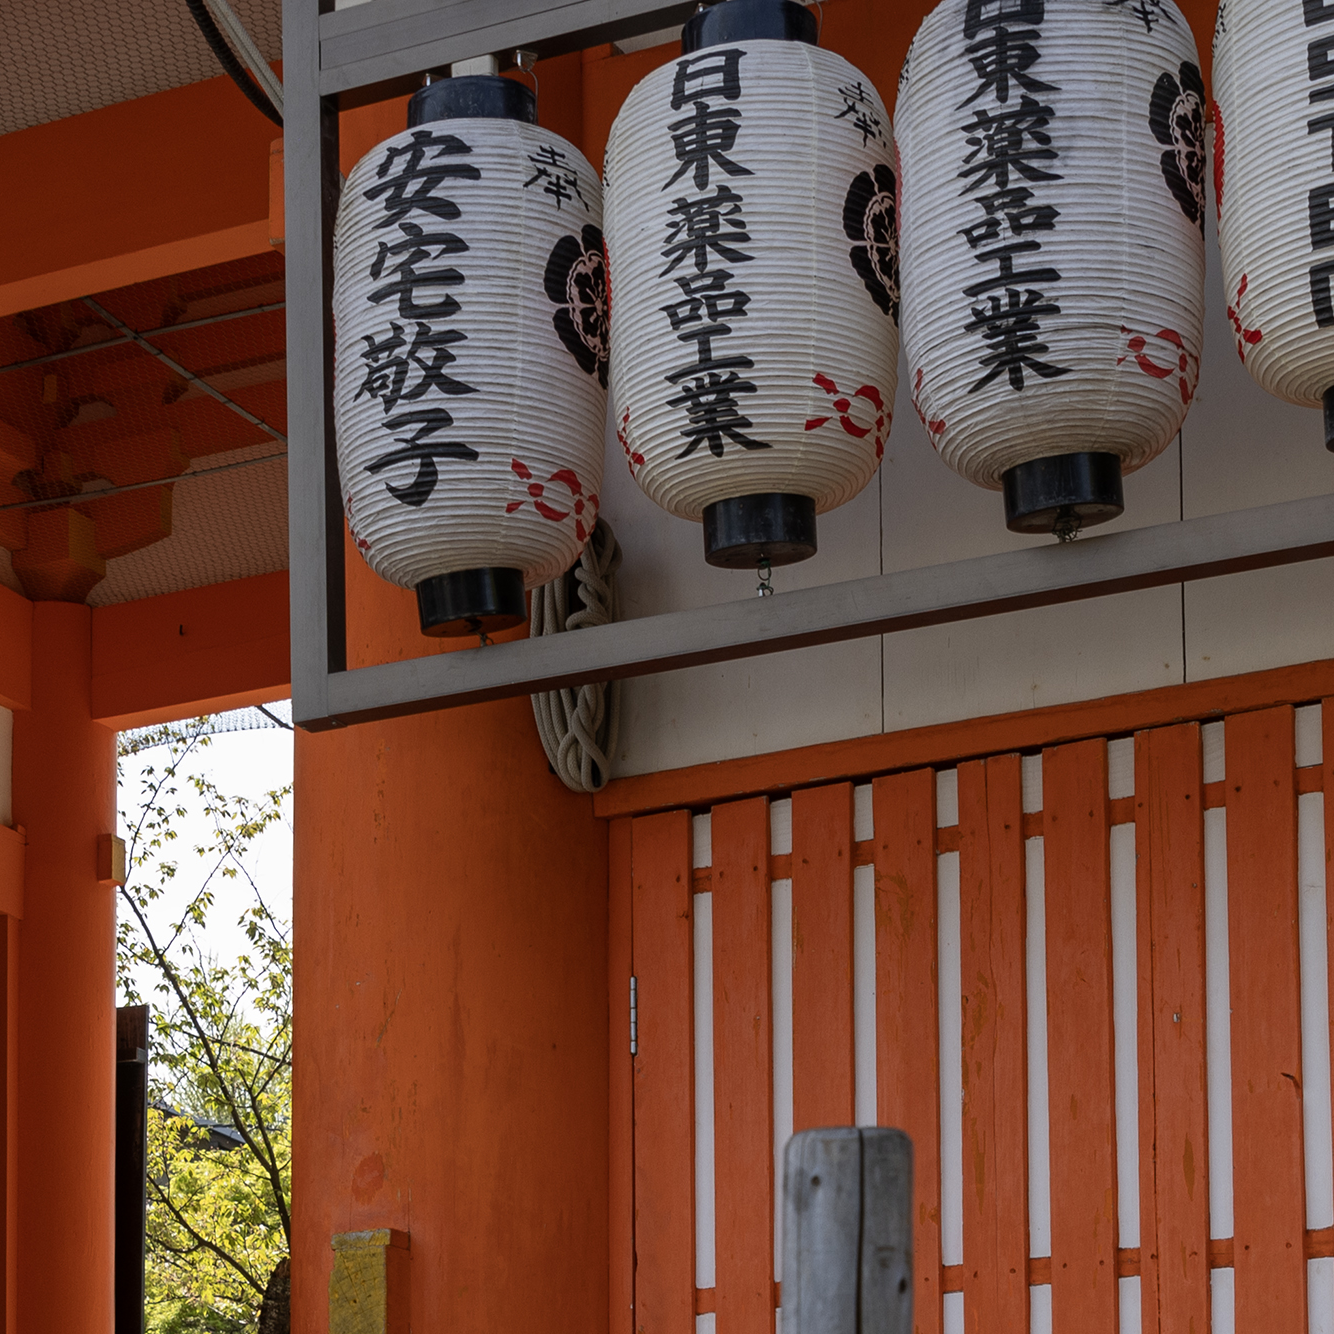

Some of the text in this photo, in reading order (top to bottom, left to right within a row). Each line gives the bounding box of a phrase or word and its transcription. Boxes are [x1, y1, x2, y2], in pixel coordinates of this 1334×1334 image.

[353, 131, 481, 506] 安宅敬子
[658, 48, 773, 461] 日東薬品工業
